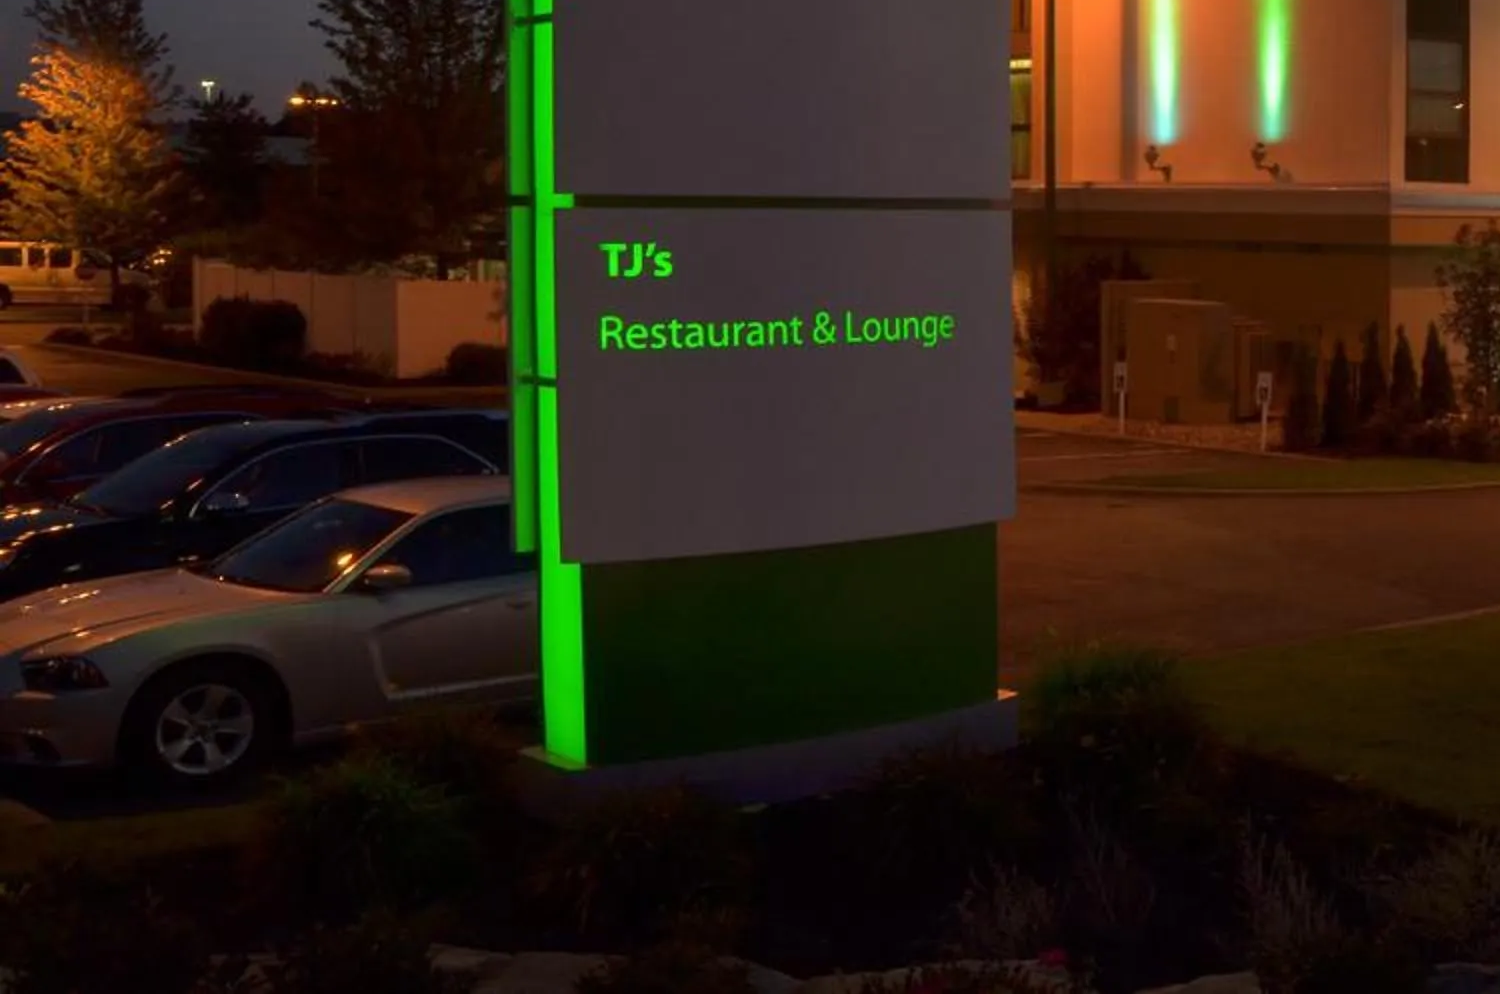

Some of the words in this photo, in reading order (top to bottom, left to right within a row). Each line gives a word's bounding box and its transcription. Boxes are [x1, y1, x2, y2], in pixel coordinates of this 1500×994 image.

[600, 242, 674, 278] TJ's
[599, 314, 804, 351] Restaurant
[812, 310, 838, 345] &
[845, 310, 957, 348] Lounge
